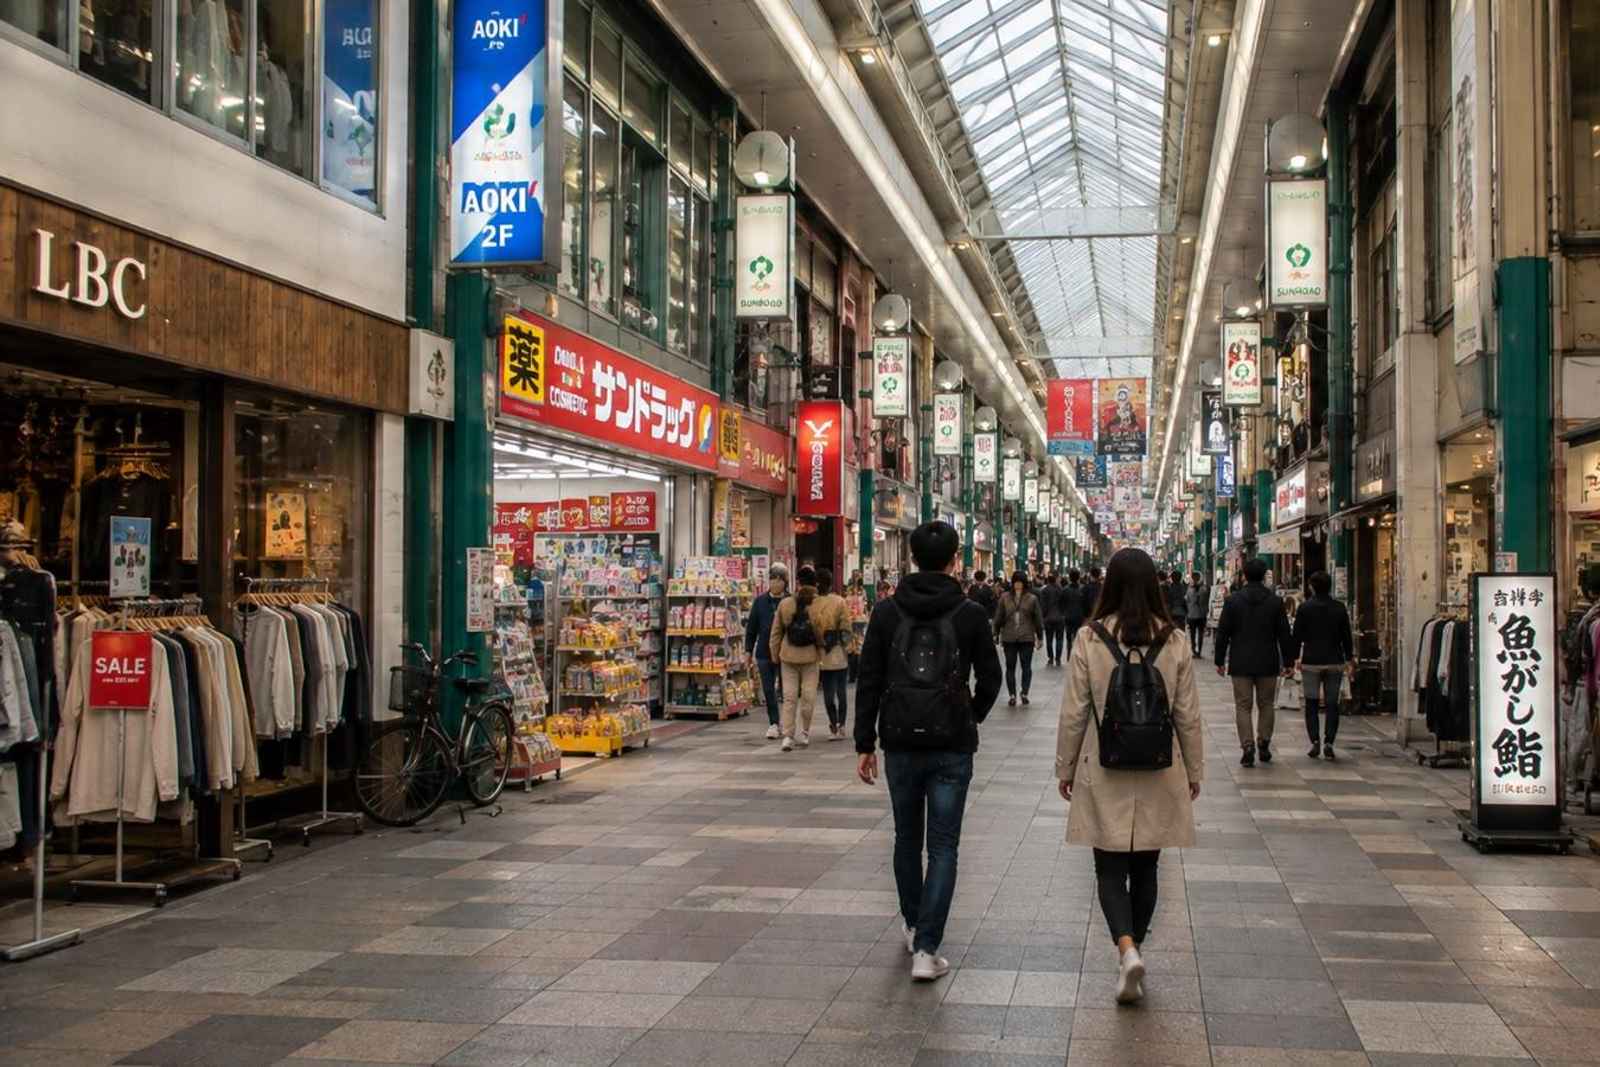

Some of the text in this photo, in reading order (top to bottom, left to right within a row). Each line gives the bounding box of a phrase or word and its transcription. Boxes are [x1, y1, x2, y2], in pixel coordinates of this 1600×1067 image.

[471, 18, 519, 39] AOKI
[463, 187, 527, 213] AOKI
[481, 223, 514, 248] 2F
[34, 228, 146, 319] LBC
[508, 324, 541, 394] 薬
[592, 360, 696, 448] サンドラッグ
[95, 657, 146, 675] SALE
[1491, 612, 1543, 780] 魚がし鮨
